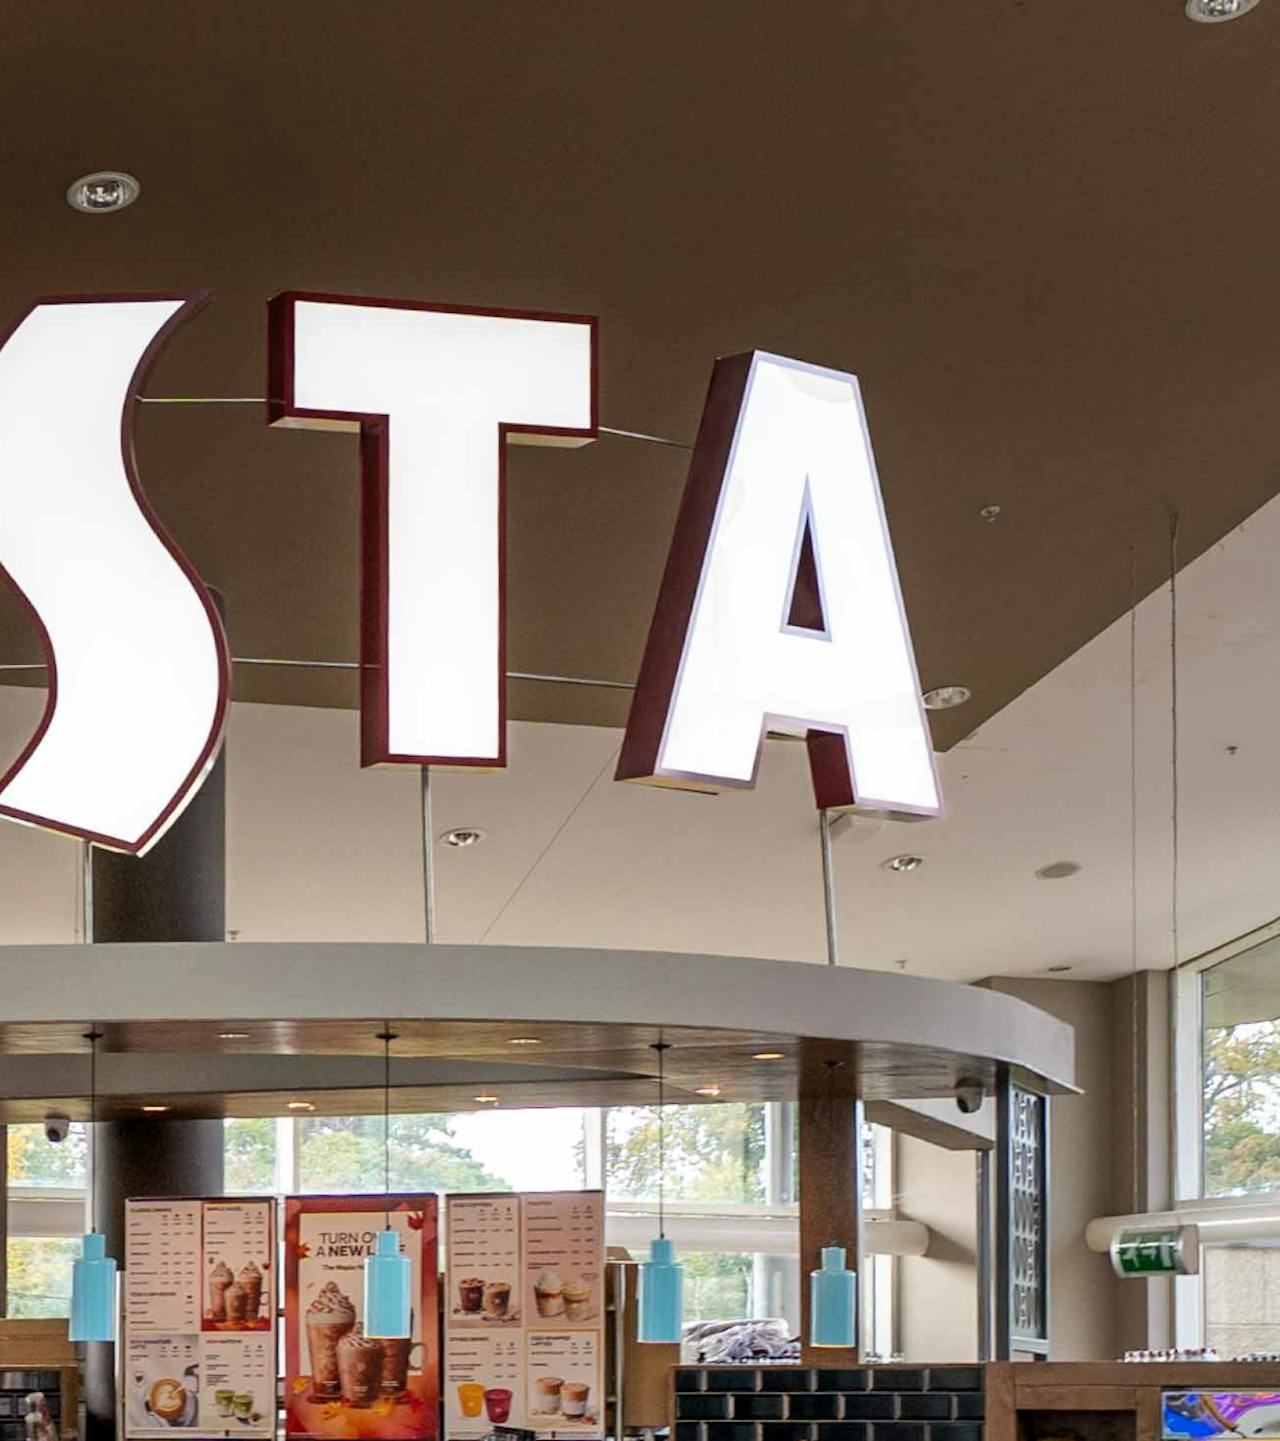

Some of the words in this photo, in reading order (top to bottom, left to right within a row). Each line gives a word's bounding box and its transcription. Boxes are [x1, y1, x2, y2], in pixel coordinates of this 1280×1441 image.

[318, 1231, 360, 1244] TURN
[316, 1246, 326, 1257] A
[328, 1245, 364, 1257] NEW
